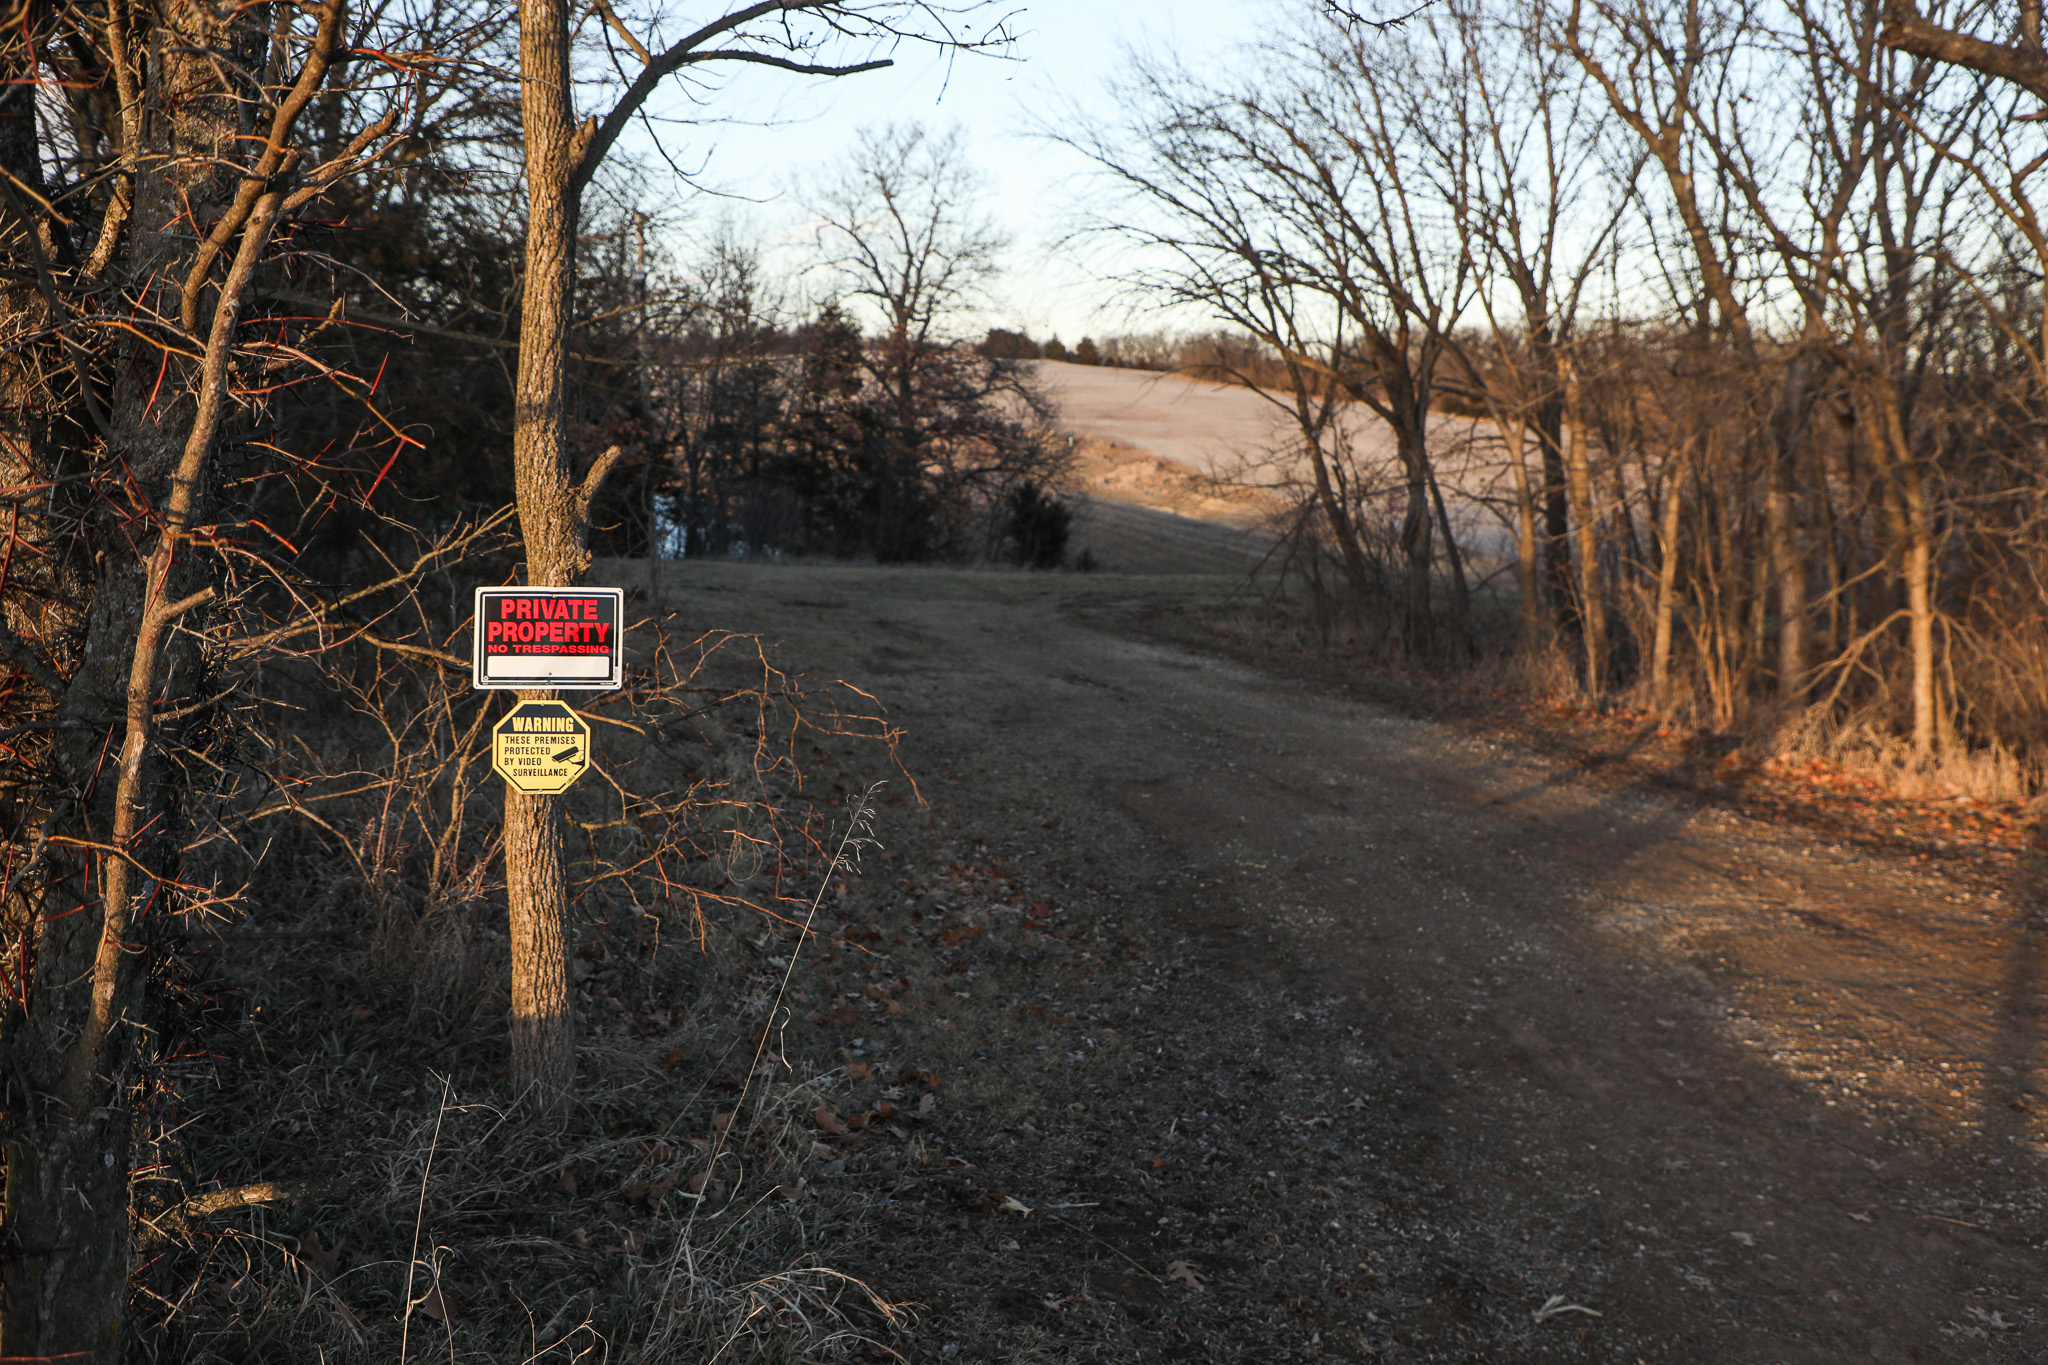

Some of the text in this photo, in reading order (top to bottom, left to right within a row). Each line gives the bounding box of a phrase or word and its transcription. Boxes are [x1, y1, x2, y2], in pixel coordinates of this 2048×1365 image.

[501, 598, 598, 620] PRIVATE
[488, 621, 610, 643] PROPERTY
[488, 644, 610, 654] NO TRESPASSING
[512, 716, 574, 732] WARNING
[505, 736, 575, 744] THESE PREMISES
[504, 747, 550, 755] PROTECTED
[504, 758, 541, 766] BY VIDEO
[513, 768, 567, 776] SURVEILLANCE
